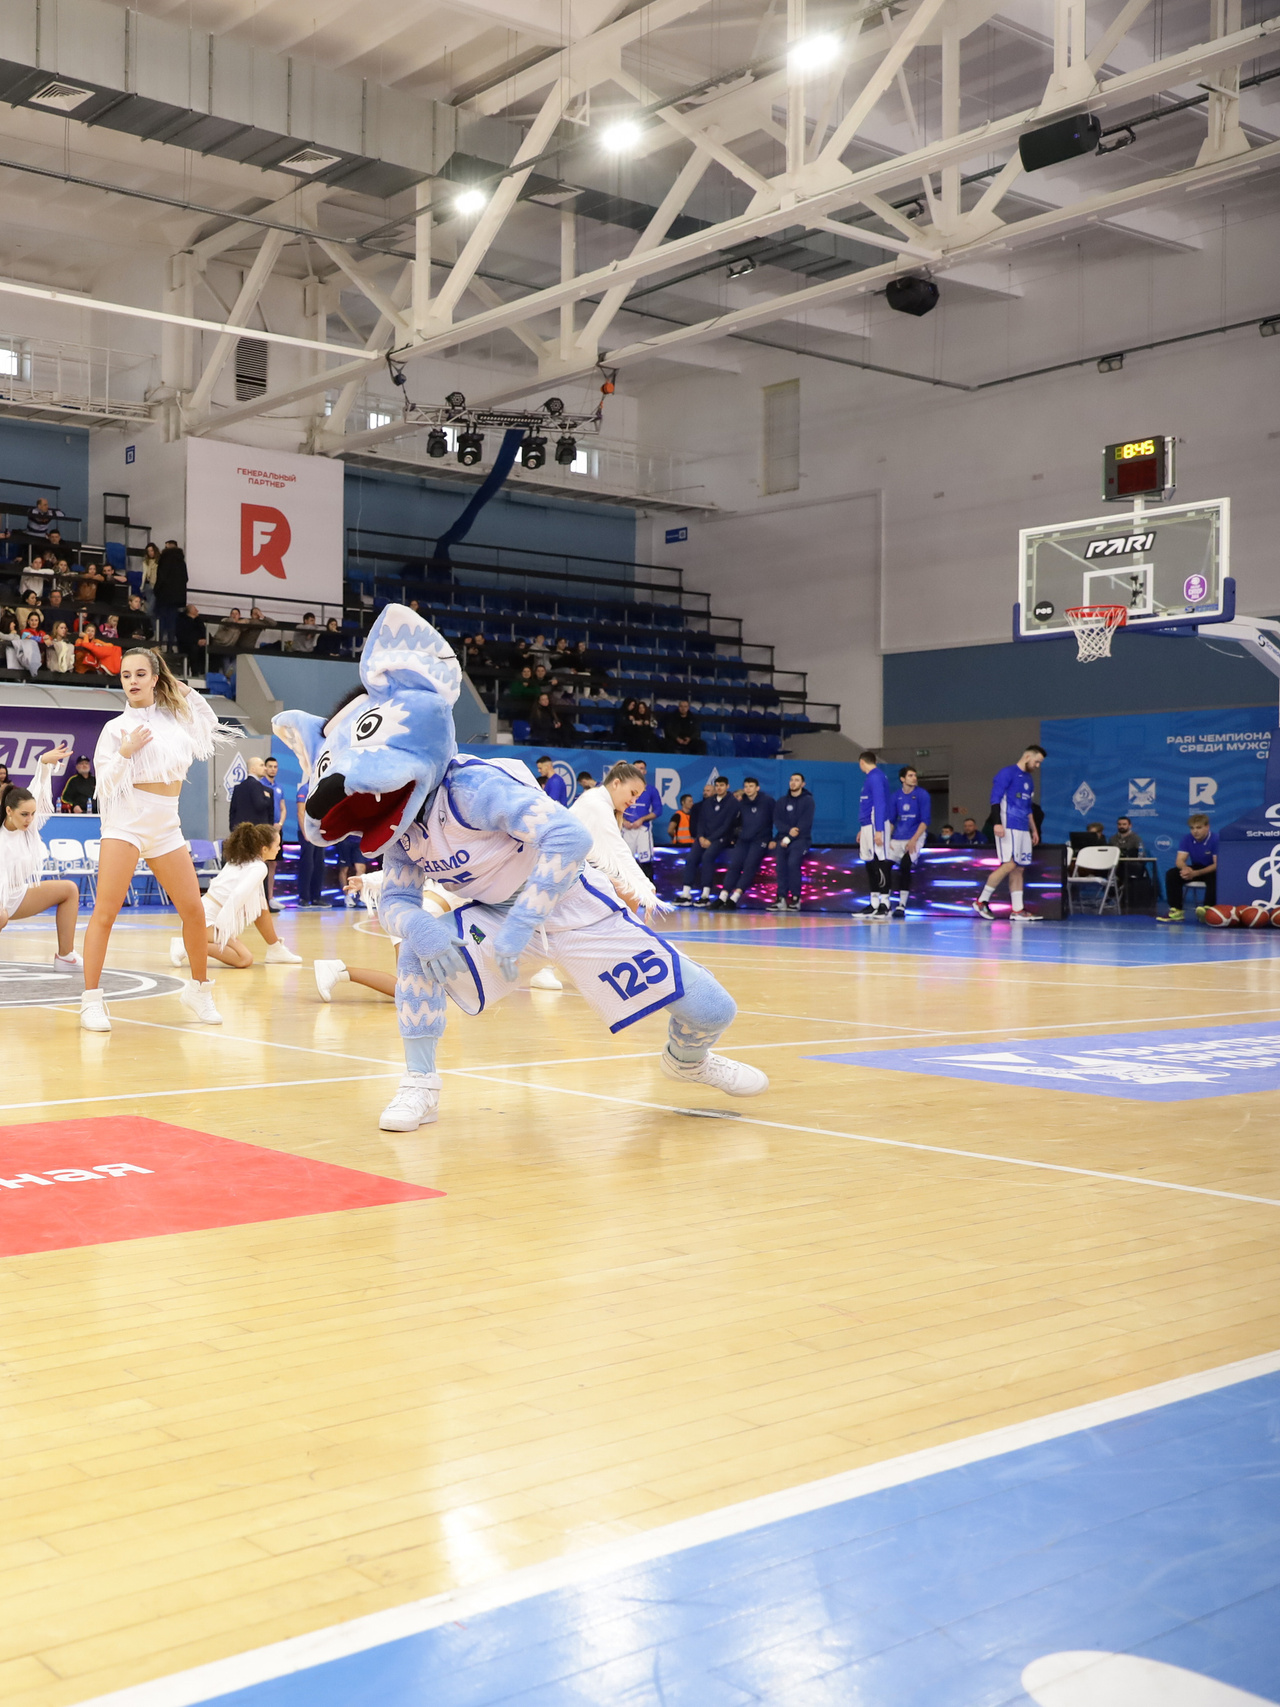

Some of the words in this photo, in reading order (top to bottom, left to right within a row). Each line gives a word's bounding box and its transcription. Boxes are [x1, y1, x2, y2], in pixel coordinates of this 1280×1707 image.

[236, 467, 296, 482] ГЕНЕРАЛЬНЫЙ
[248, 477, 286, 489] ПАРТНЕР
[1086, 533, 1154, 558] PARI
[1166, 735, 1196, 744] PARI
[1199, 732, 1272, 742] ЧЕМПИОНА
[1179, 744, 1223, 753] СРЕДИ
[1227, 741, 1270, 751] МУЖС
[424, 849, 470, 872] НАМО
[598, 949, 669, 1001] 125
